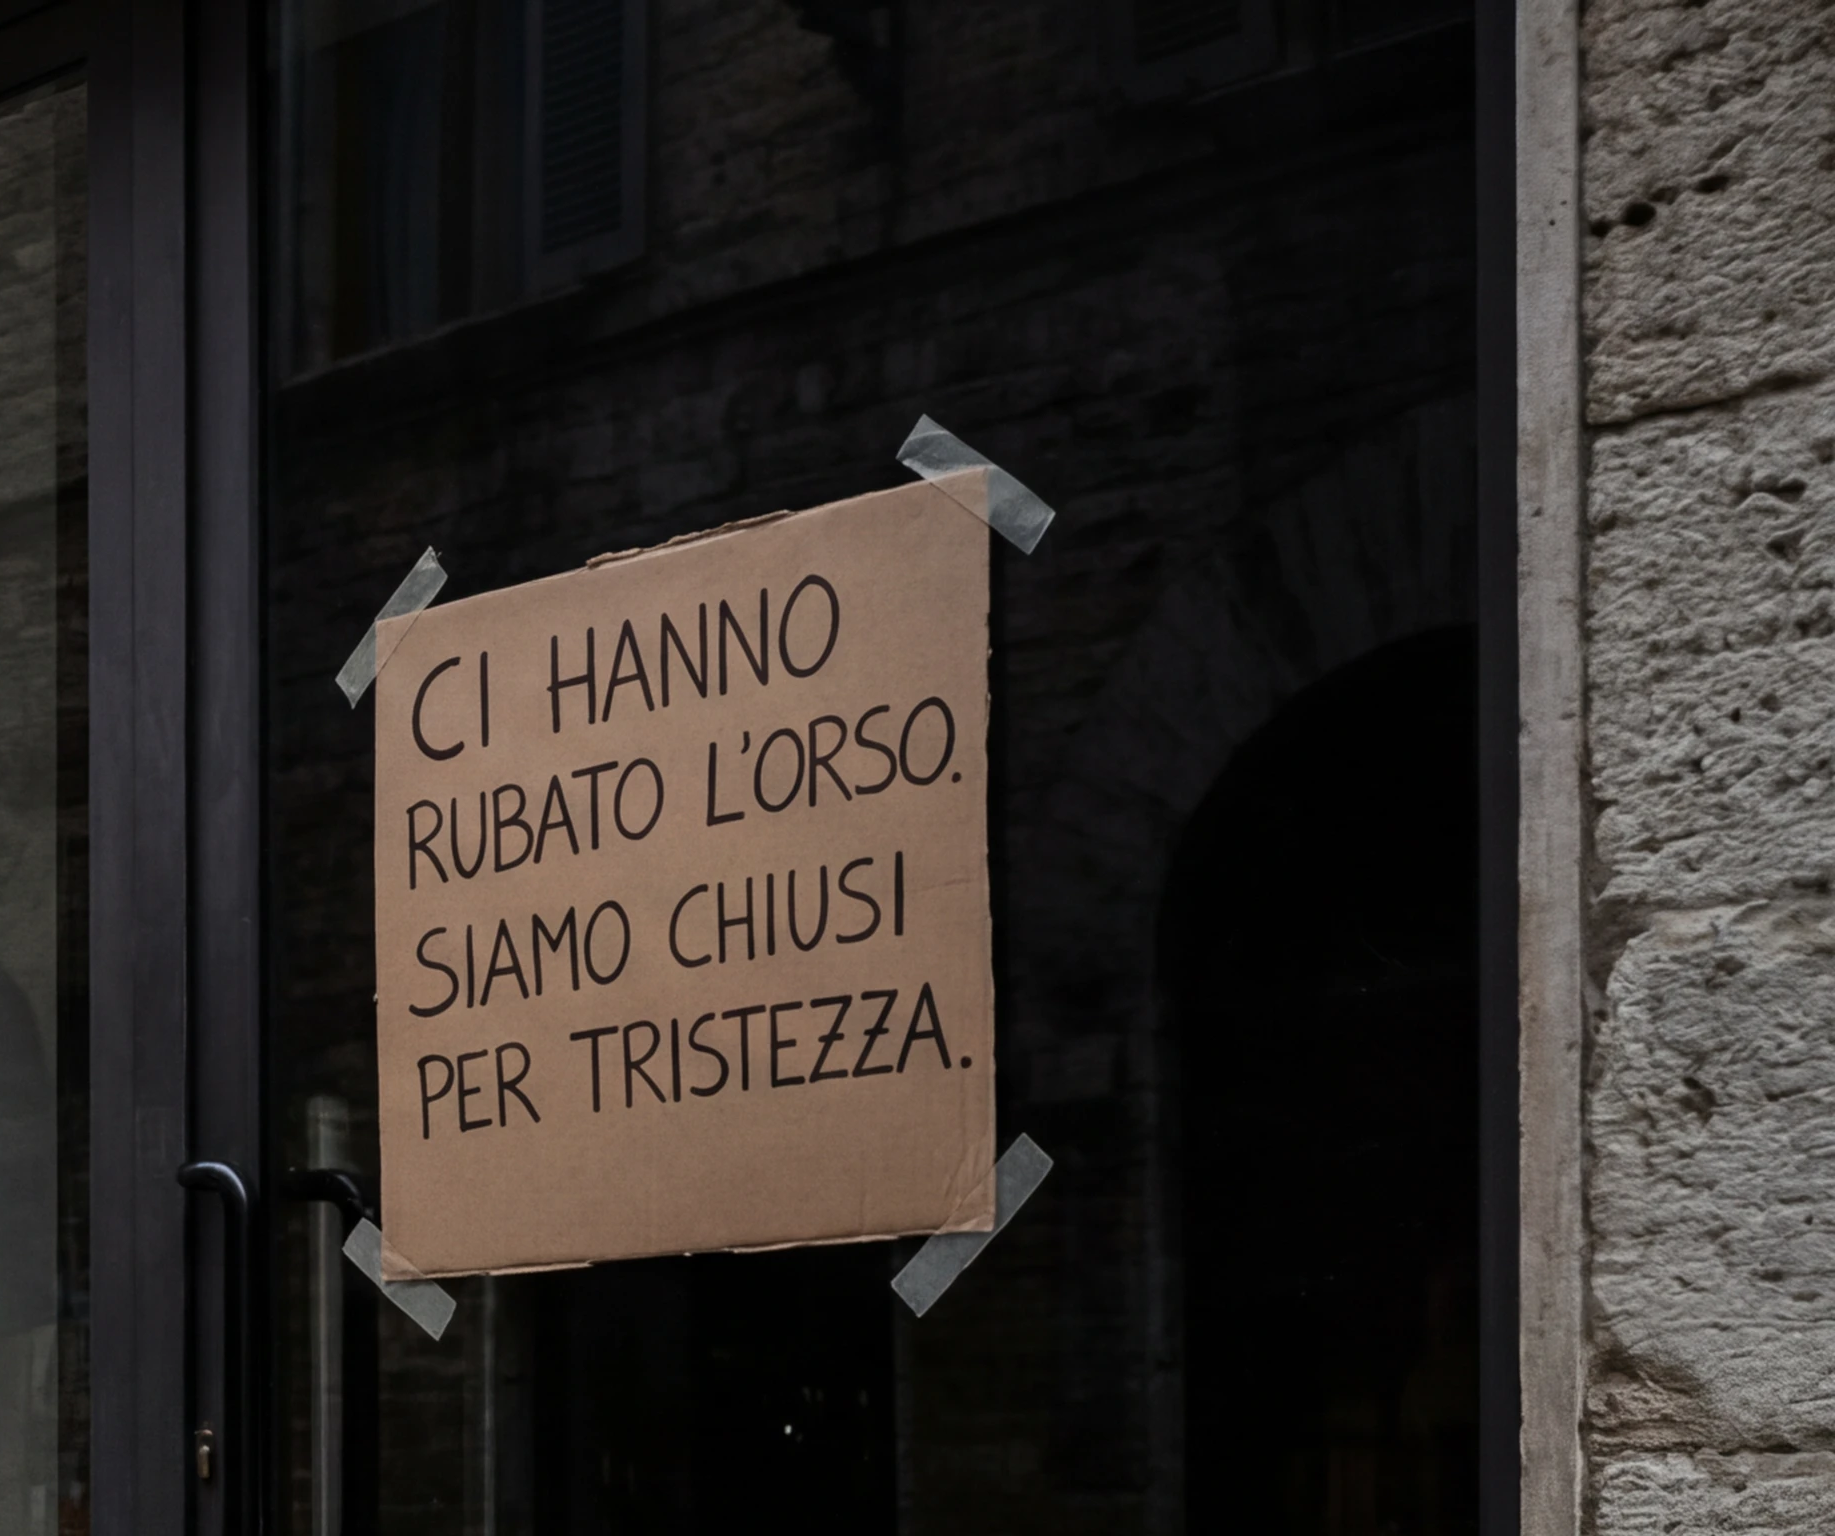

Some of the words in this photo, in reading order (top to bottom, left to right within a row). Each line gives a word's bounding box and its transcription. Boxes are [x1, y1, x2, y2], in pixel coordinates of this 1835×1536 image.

[411, 651, 490, 762] CI
[546, 574, 840, 734] HANNO
[406, 757, 664, 890] RUBATO
[706, 696, 962, 827] L'ORSO.
[408, 900, 631, 1018] SIAMO
[669, 850, 905, 969] CHIUSI
[416, 1042, 541, 1140] PER
[569, 981, 973, 1113] TRISTEZZA.
